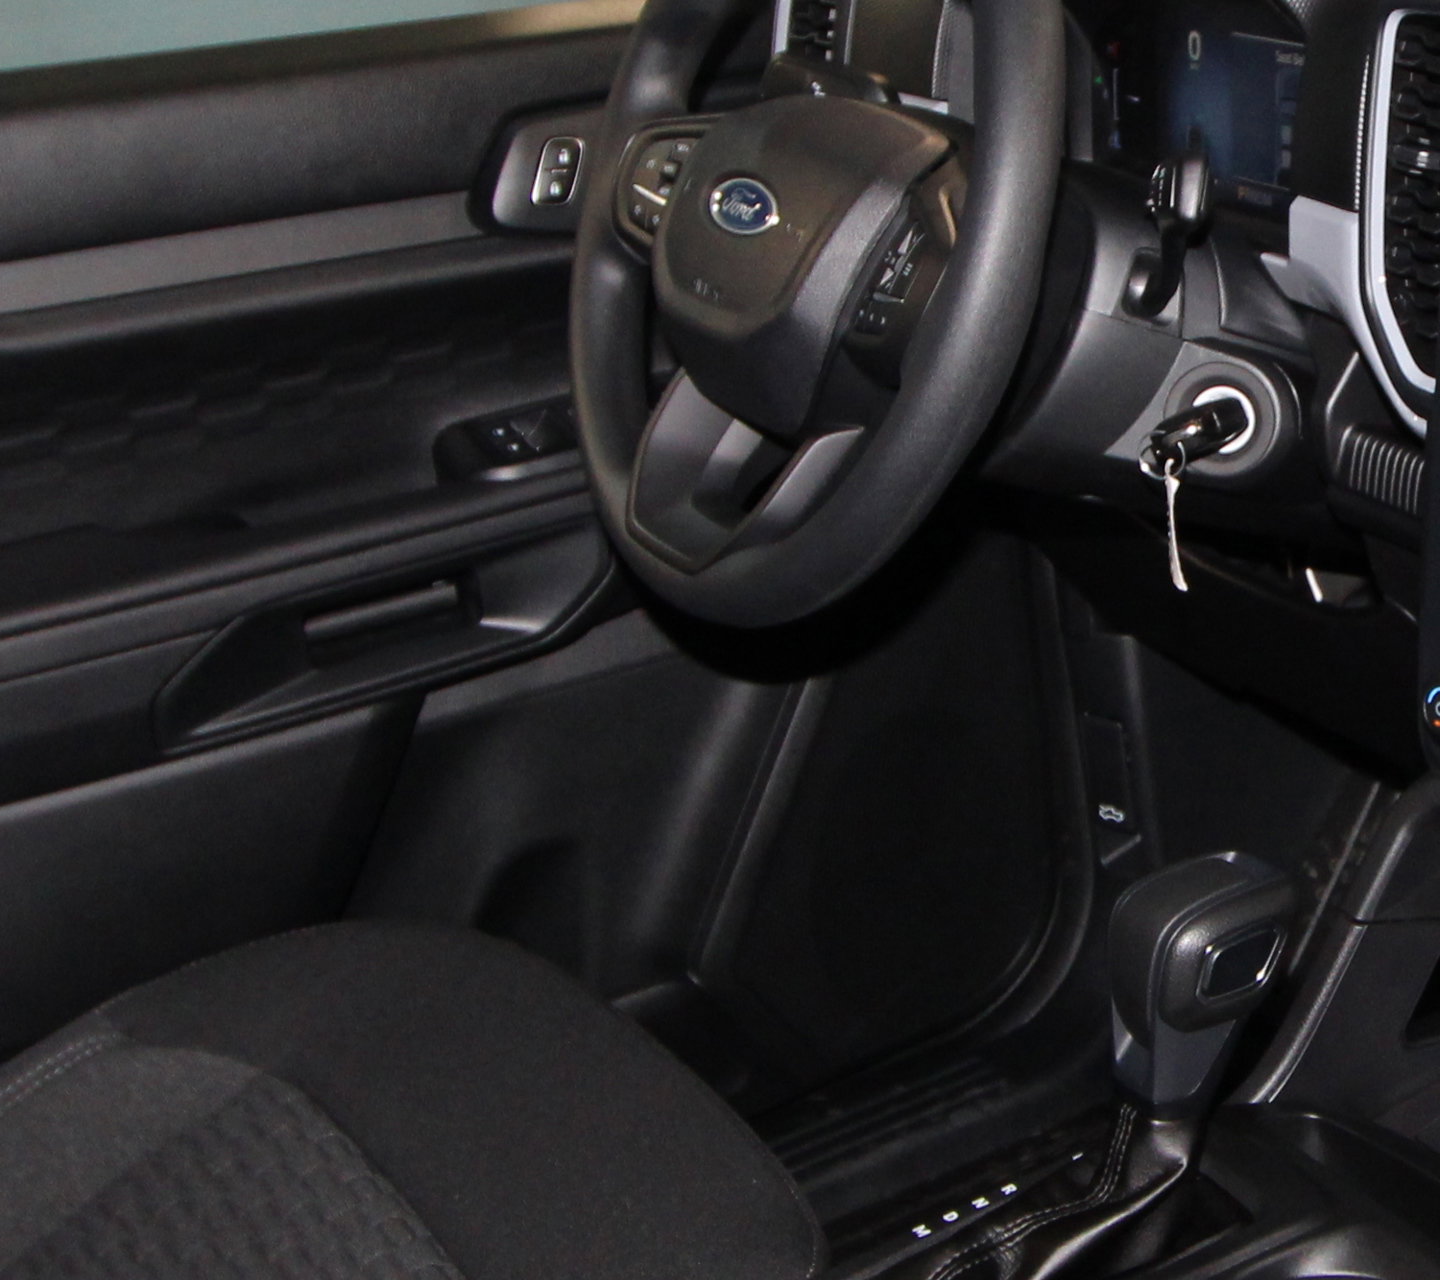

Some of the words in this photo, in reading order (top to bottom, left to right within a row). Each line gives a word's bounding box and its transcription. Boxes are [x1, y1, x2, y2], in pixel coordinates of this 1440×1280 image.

[1000, 1183, 1018, 1196] R
[971, 1196, 990, 1210] N
[943, 1210, 959, 1223] D
[912, 1224, 932, 1239] M
